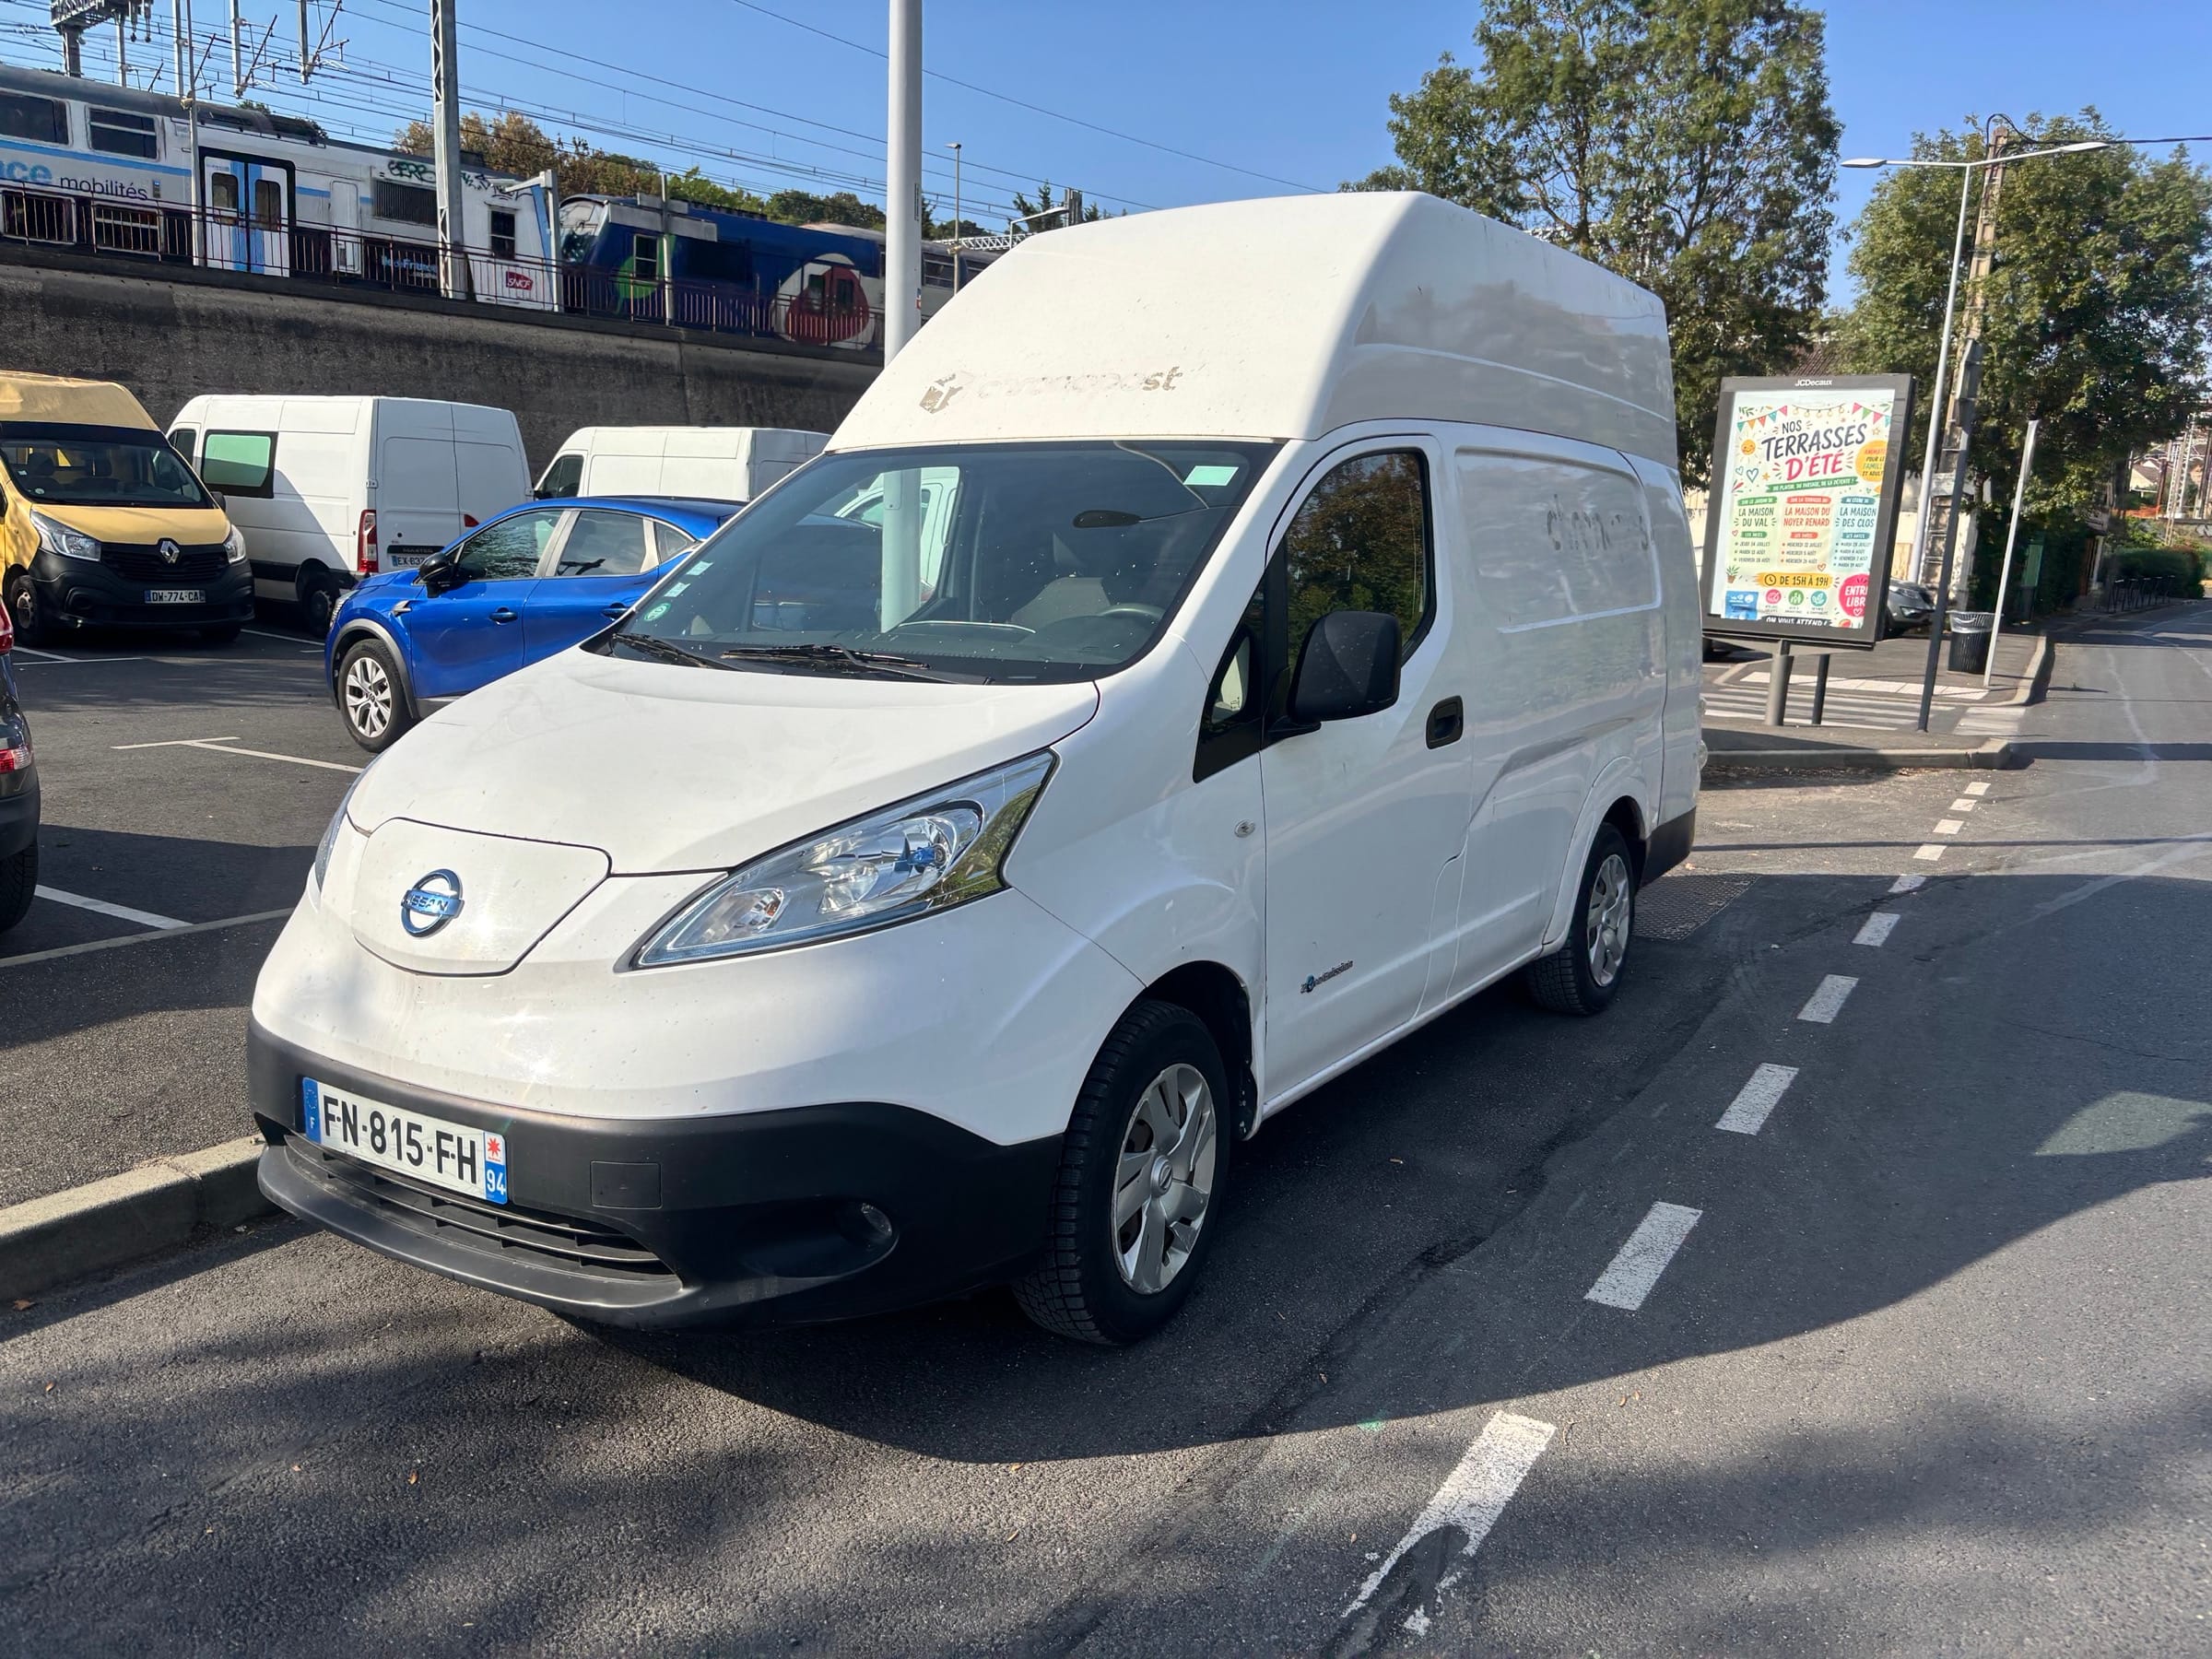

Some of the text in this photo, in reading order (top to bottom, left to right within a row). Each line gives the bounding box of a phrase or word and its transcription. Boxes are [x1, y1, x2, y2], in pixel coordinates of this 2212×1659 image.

[0, 160, 148, 201] ce mobilités
[508, 276, 531, 288] SNCF
[1783, 419, 1802, 434] NOS
[1761, 423, 1867, 461] TERRASSES
[1785, 449, 1844, 481] D'ÉTÉ
[1747, 507, 1774, 516] MAISON
[1784, 507, 1830, 516] LA MAISON DU
[1840, 507, 1877, 516] LA MAISON
[1742, 517, 1769, 527] DU VAL
[1783, 517, 1830, 527] NOYER RENARD
[1841, 518, 1875, 527] DES CLOS
[1780, 575, 1829, 587] DE 15H À 19H
[152, 592, 199, 602] DW-774-CA
[310, 1094, 507, 1196] F FN-815-FH 94
